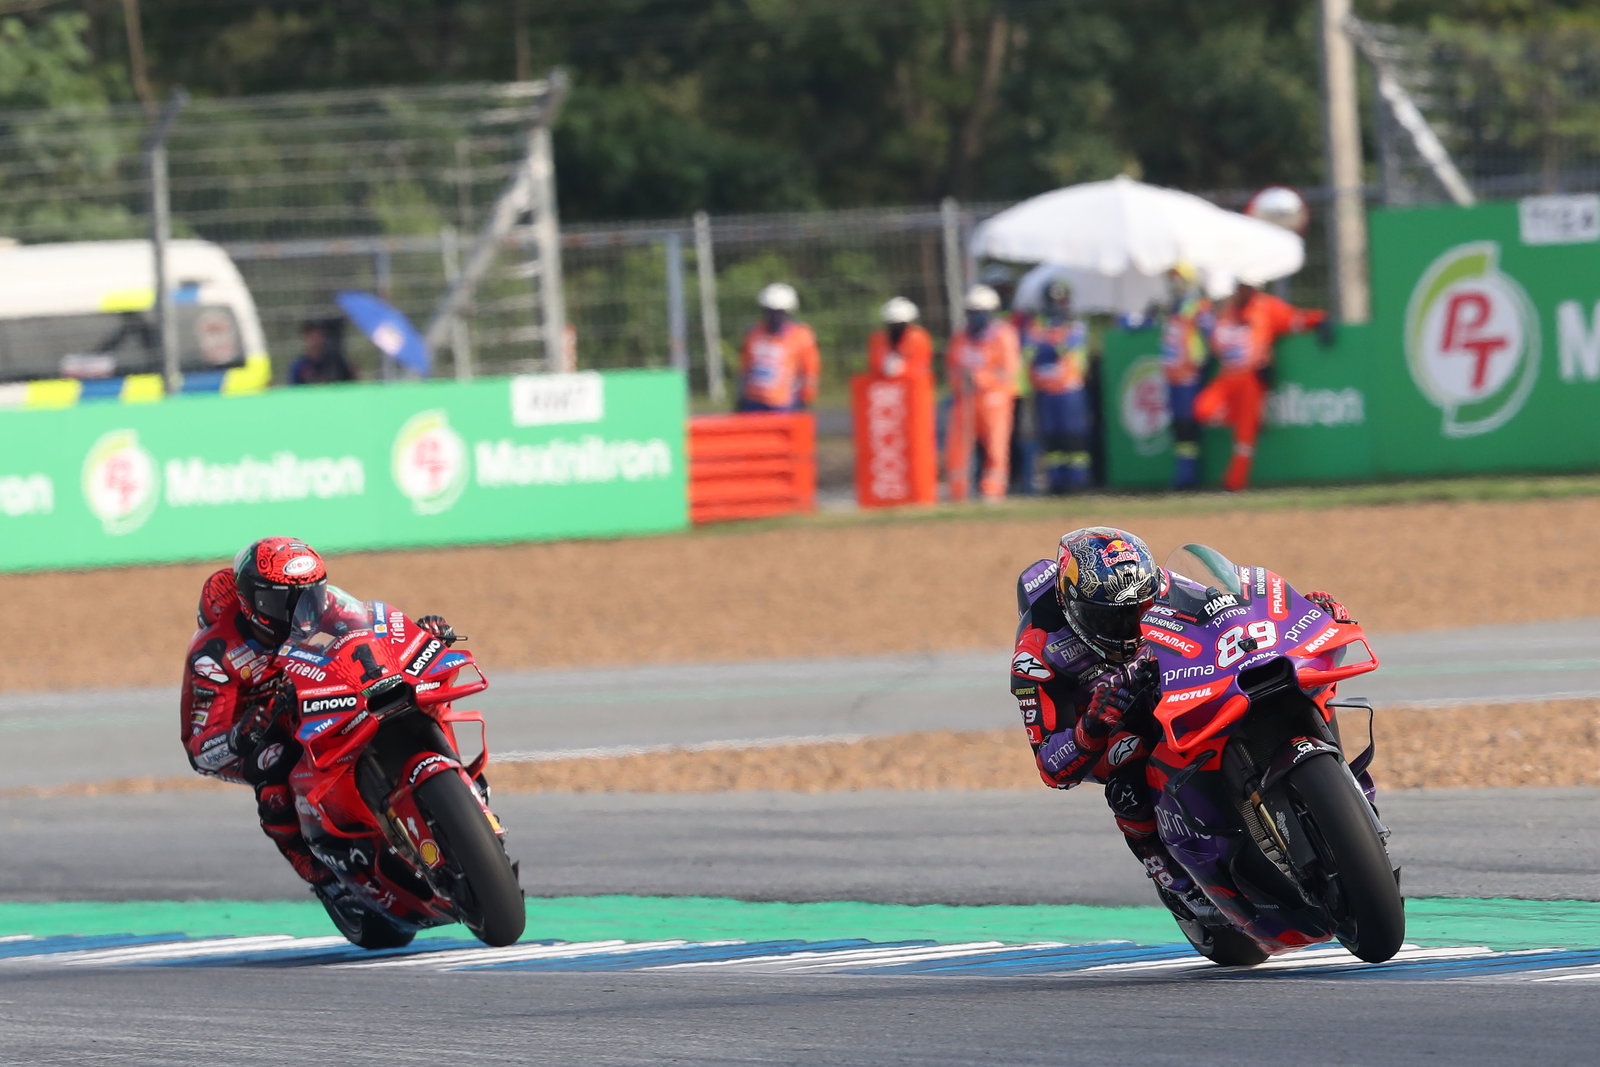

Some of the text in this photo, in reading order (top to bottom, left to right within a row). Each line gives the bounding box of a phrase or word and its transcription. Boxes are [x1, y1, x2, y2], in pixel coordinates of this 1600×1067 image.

[1441, 290, 1509, 391] PT
[1203, 594, 1239, 617] FIAMM
[1271, 577, 1284, 614] PRAMAC
[1212, 607, 1248, 628] prima
[1284, 608, 1322, 643] prima
[1146, 629, 1195, 653] PRAMAC
[1217, 620, 1278, 669] 89
[1304, 627, 1340, 653] MOTUL
[404, 639, 442, 677] Lenovo
[1237, 650, 1280, 671] PRAMAC
[1162, 664, 1215, 686] prima
[302, 696, 358, 714] Lenovo
[1165, 687, 1213, 703] MOTUL
[314, 718, 334, 733] TIM
